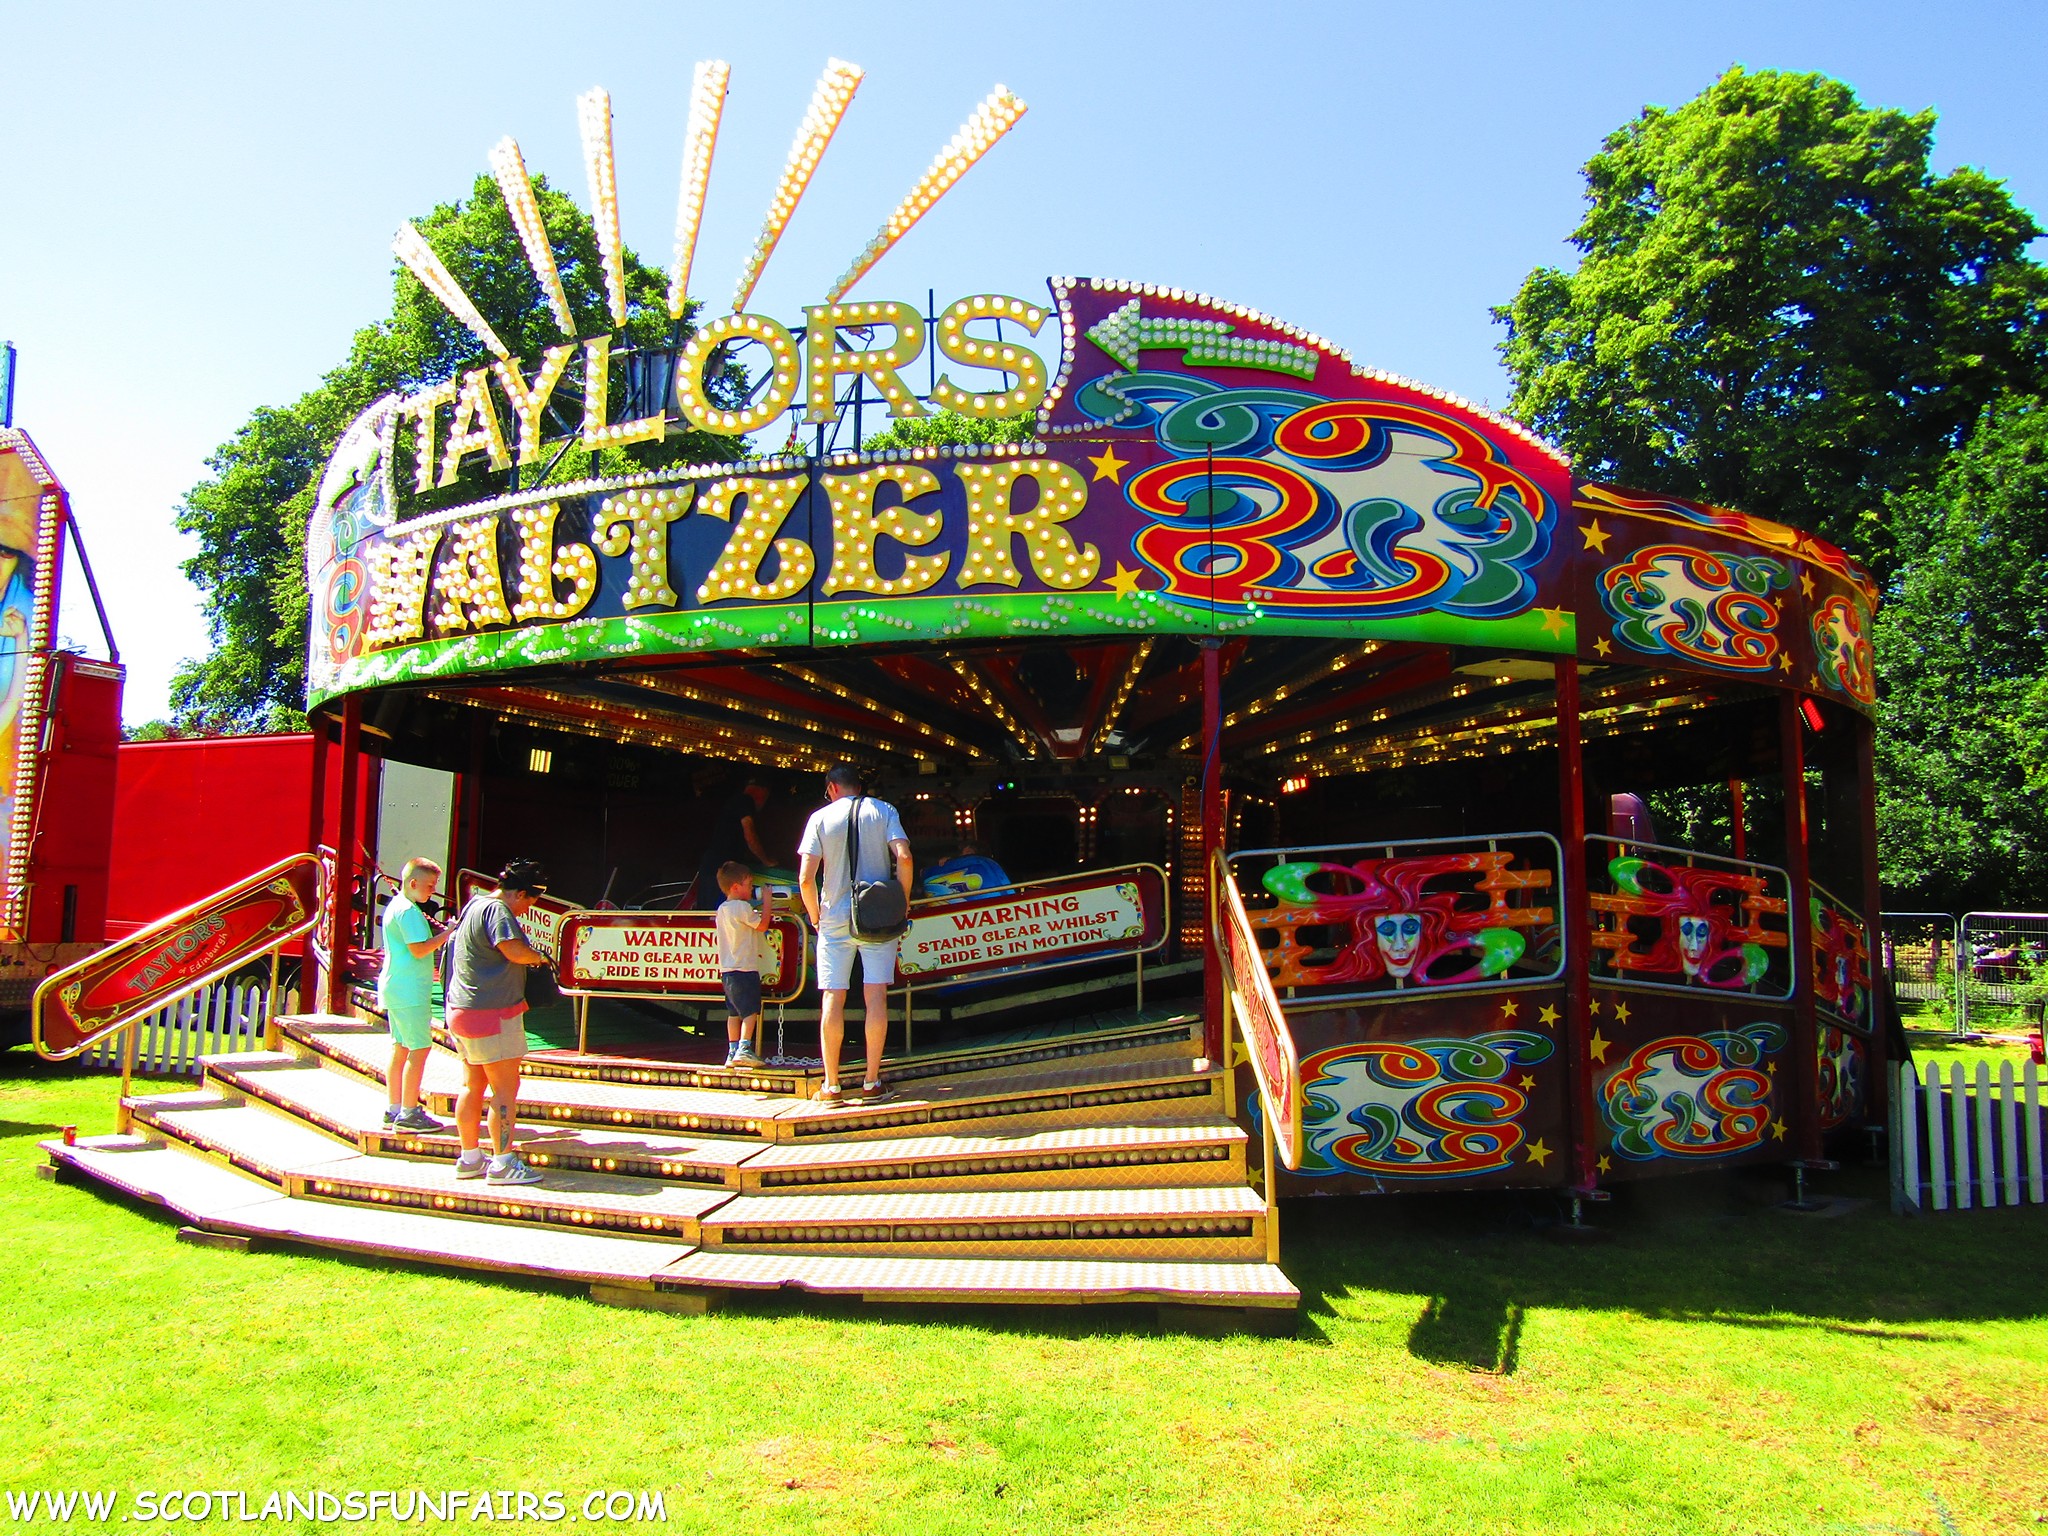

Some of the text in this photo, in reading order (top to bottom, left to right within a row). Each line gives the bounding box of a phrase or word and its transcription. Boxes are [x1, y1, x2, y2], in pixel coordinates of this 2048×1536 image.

[396, 294, 1051, 494] TAYLORS
[363, 458, 1102, 647] WALTZER
[918, 910, 1120, 954] STAND CLEAR WHILST
[951, 896, 1080, 931] WARNING
[189, 932, 228, 973] Edinburgh
[591, 950, 640, 963] STAND
[643, 951, 693, 964] CLEAR
[939, 928, 1103, 965] RIDE IS IN MOTION
[606, 966, 724, 980] RIDE IS IN MOTI
